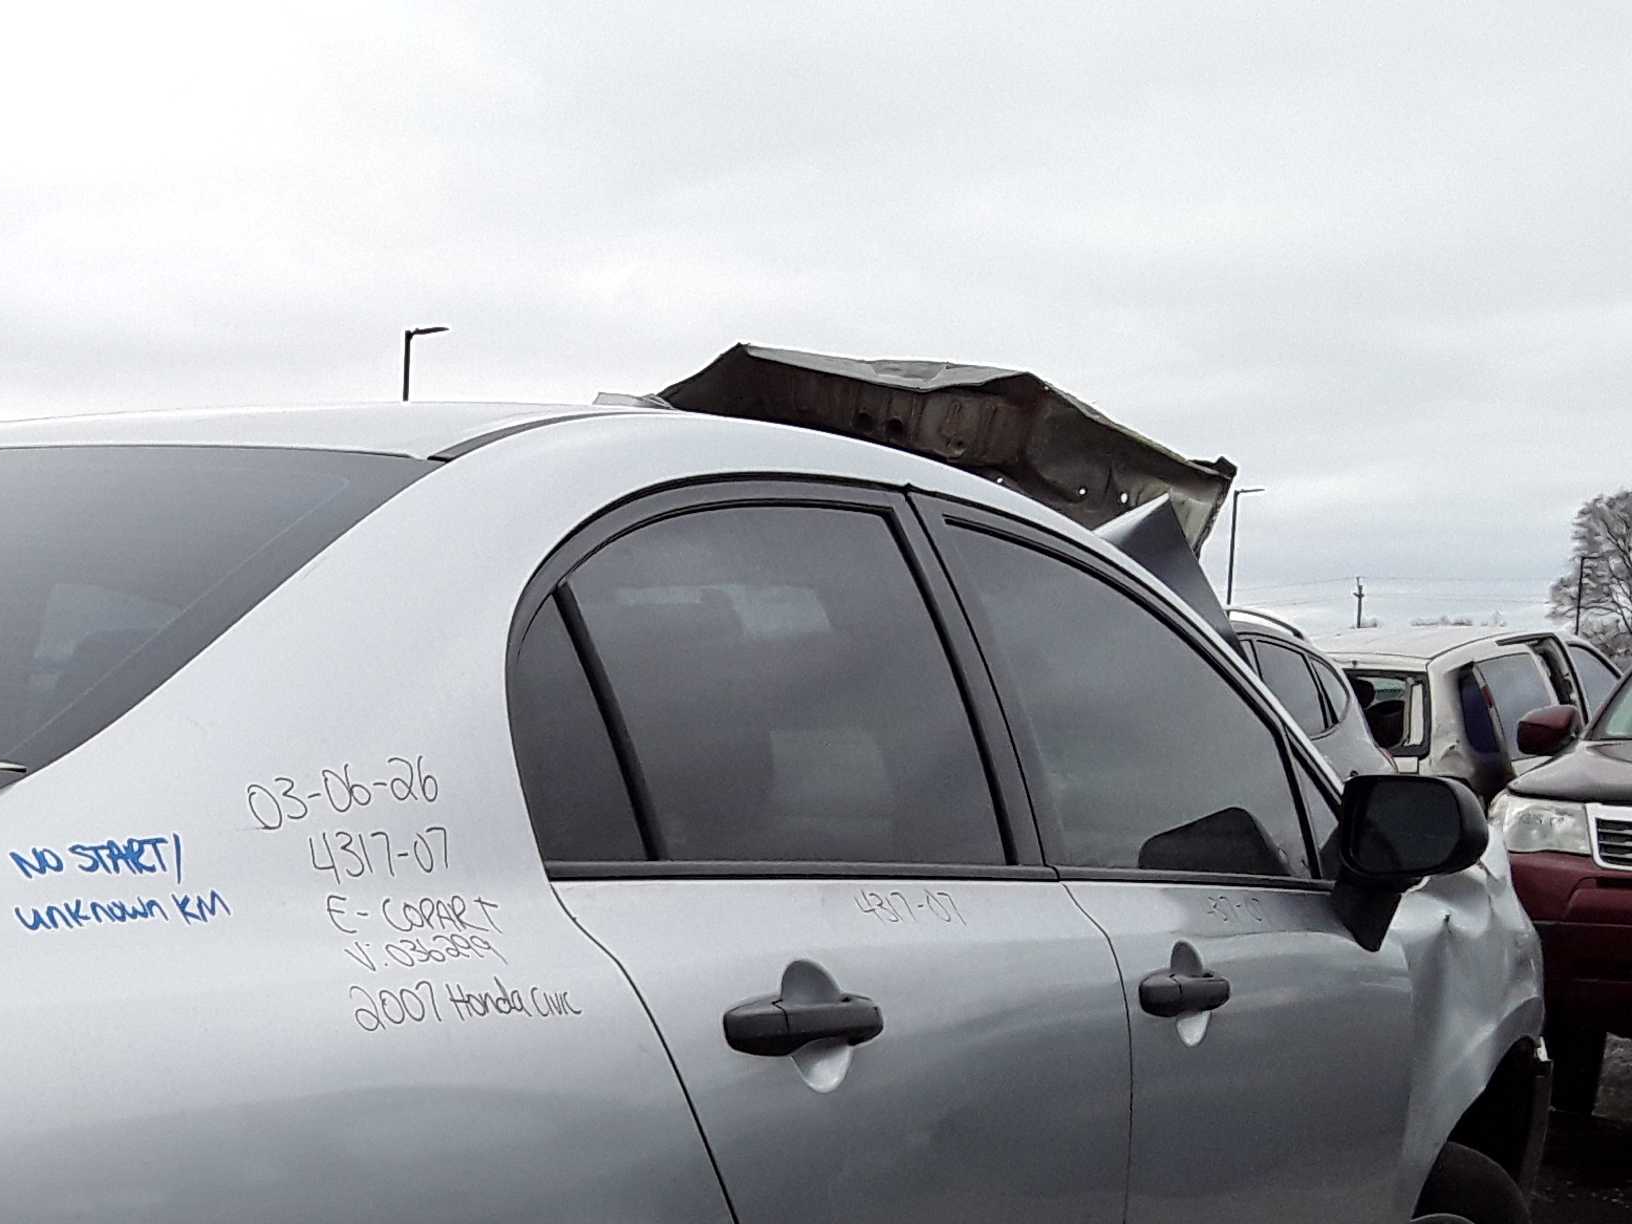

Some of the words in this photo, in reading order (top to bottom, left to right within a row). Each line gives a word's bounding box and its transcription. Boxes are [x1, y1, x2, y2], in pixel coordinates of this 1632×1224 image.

[247, 755, 438, 830] 03-06-26
[9, 847, 64, 879] NO
[308, 826, 449, 885] 4317-07
[170, 889, 231, 925] KM
[349, 980, 443, 1032] 2007
[445, 976, 532, 1021] Honda
